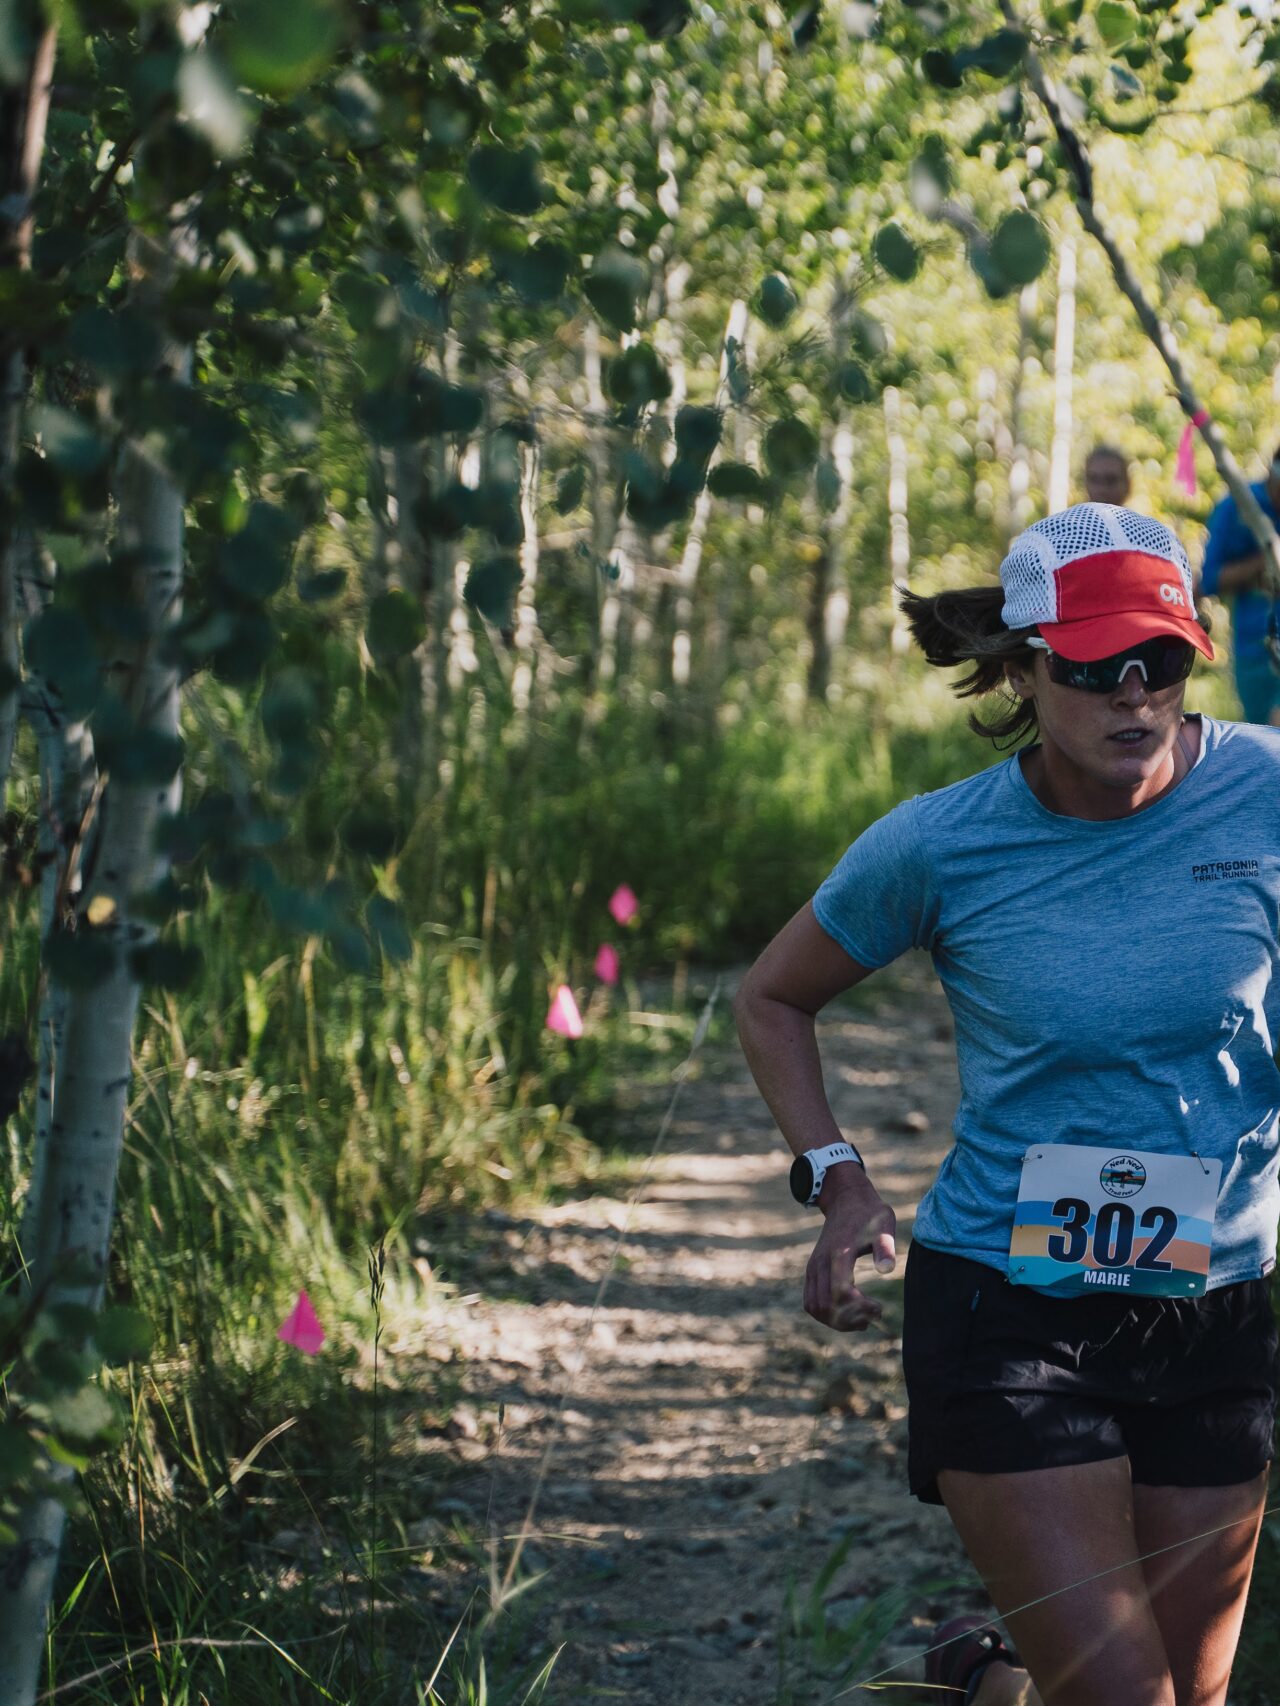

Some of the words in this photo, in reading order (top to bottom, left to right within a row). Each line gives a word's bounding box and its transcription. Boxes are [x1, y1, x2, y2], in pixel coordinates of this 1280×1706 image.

[1160, 583, 1185, 607] OR
[1192, 860, 1258, 875] PATAGONIA
[1193, 873, 1220, 882] TRAIL
[1222, 870, 1259, 879] RUNNING
[1109, 1158, 1126, 1168] Ned
[1126, 1160, 1143, 1171] Ned
[1047, 1197, 1178, 1272] 302
[1083, 1270, 1131, 1287] MARIE
